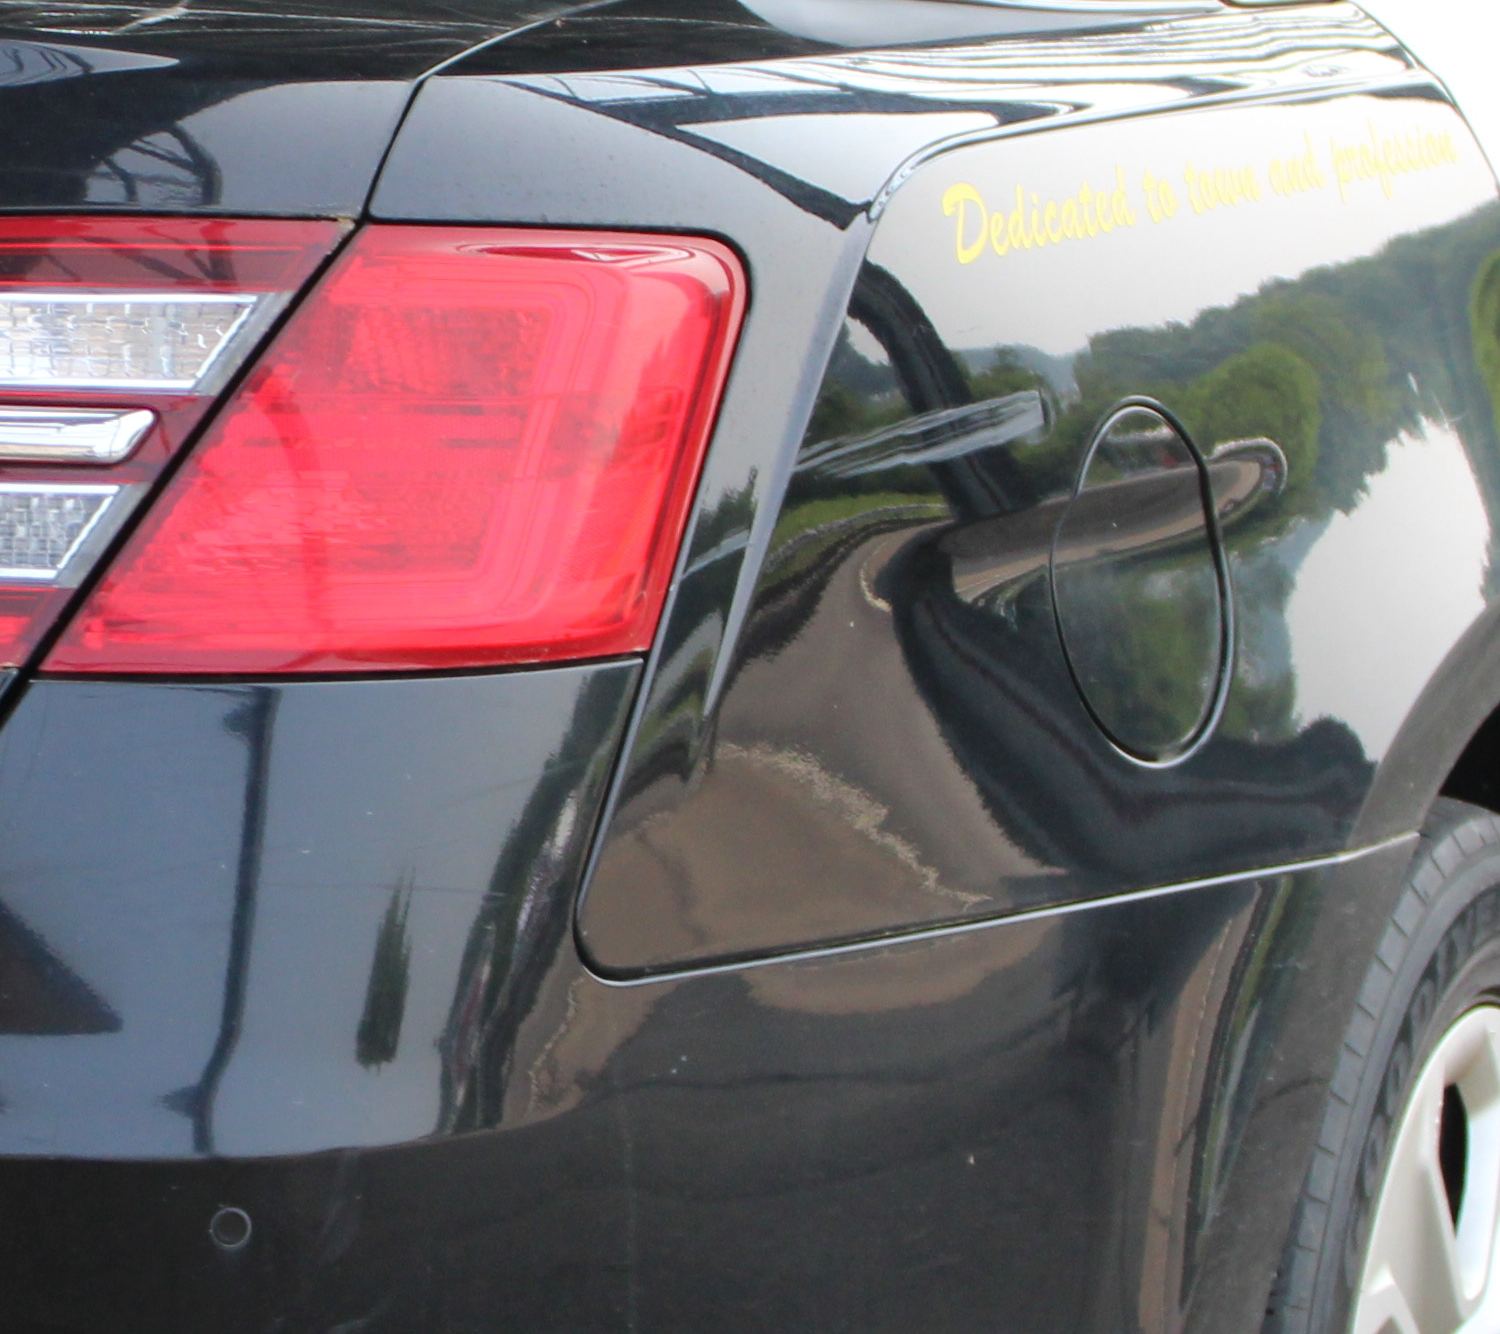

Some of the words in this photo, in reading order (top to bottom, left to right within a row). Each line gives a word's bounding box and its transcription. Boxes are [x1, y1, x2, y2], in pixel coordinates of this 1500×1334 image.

[941, 167, 1136, 265] Dedicated
[1142, 167, 1179, 224] to
[1183, 159, 1261, 215] town
[1269, 129, 1326, 197] and
